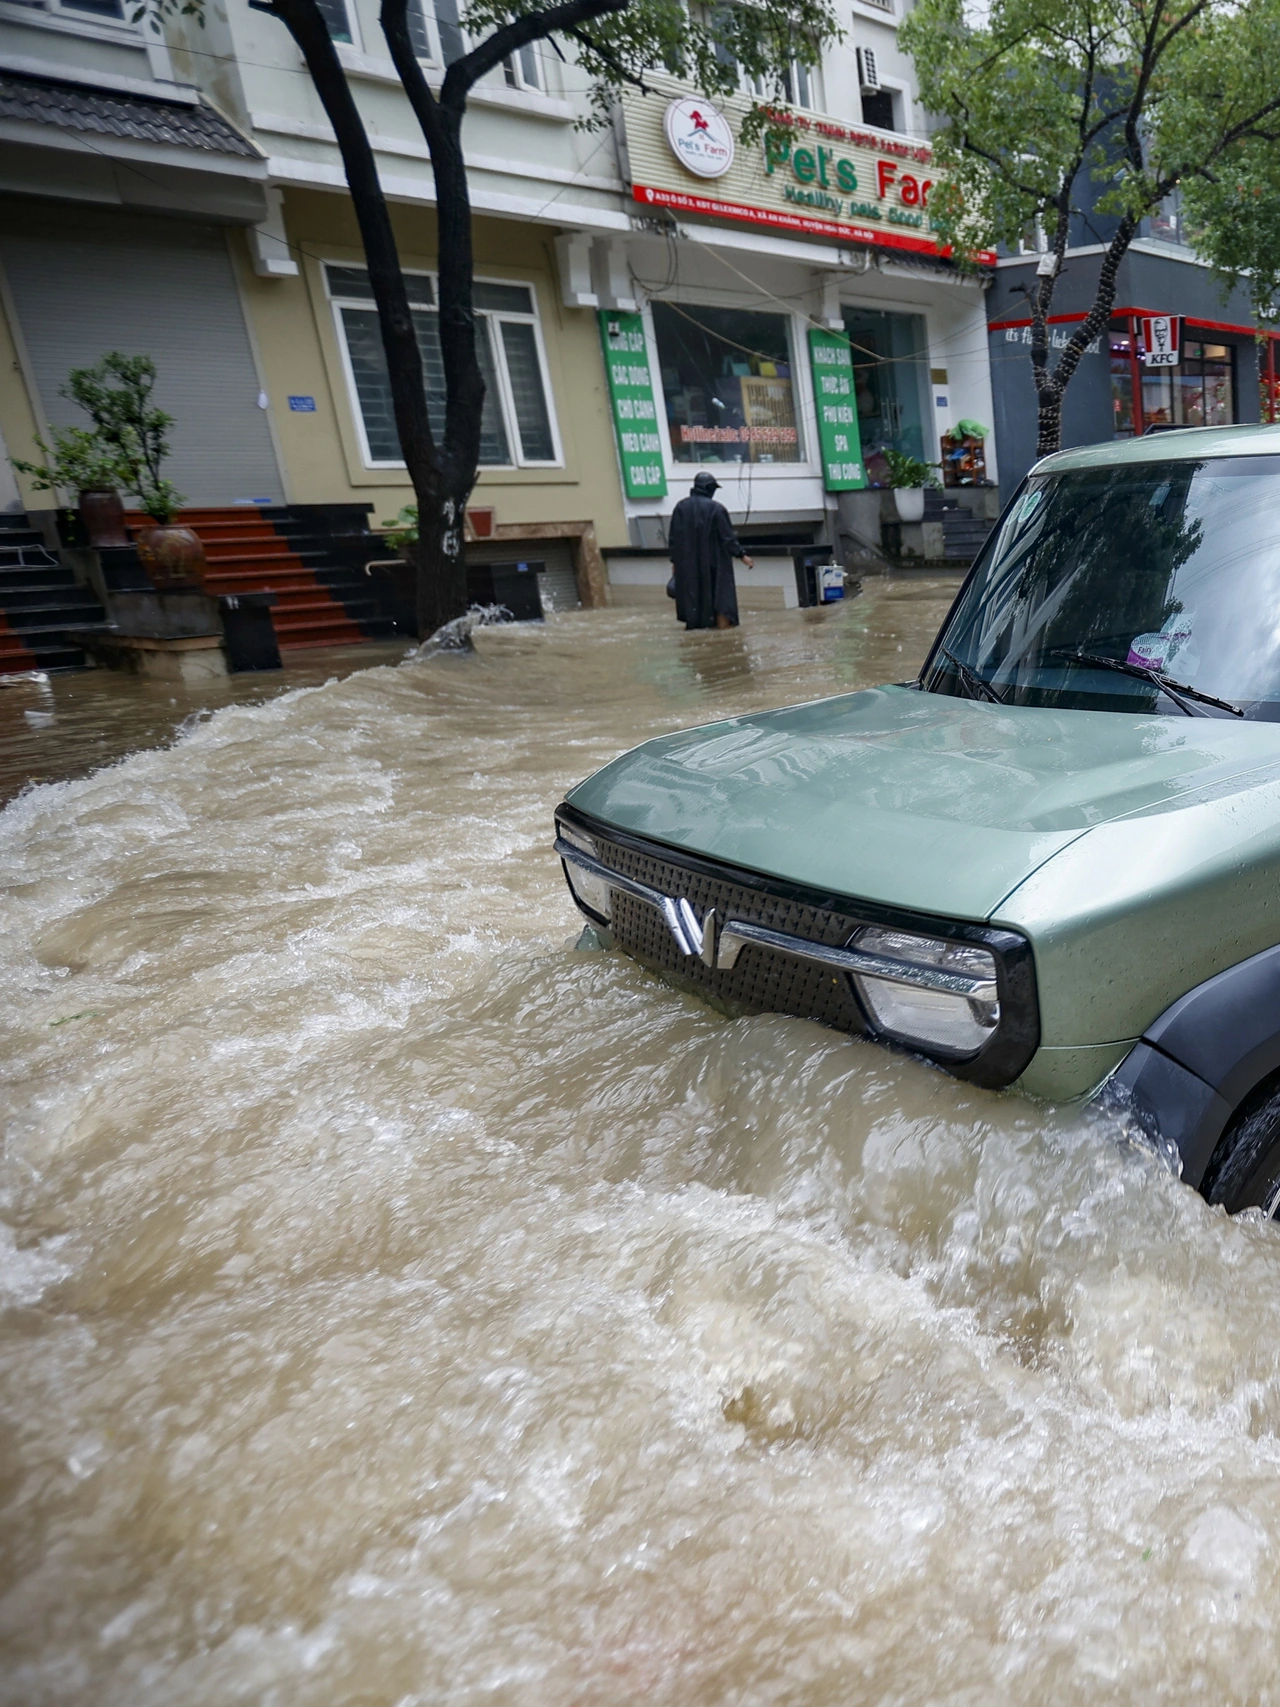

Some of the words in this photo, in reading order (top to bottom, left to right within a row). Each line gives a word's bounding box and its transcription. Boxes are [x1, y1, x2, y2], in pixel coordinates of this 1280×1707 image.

[704, 143, 728, 157] Farm
[763, 128, 859, 193] Pet's
[784, 184, 844, 217] Healthy
[887, 207, 923, 228] Good
[767, 213, 778, 222] AN
[813, 343, 836, 364] KHÁCH
[836, 347, 850, 369] SẠN
[1151, 353, 1174, 364] KFC
[612, 361, 628, 385] CÁC
[824, 405, 838, 427] PHỤ
[838, 403, 854, 427] KIỆN
[834, 434, 849, 452] SPA
[630, 465, 646, 485] CAO
[646, 459, 661, 485] CẤP
[828, 460, 842, 480] THÚ
[842, 462, 861, 480] CƯNG
[1137, 645, 1152, 655] Fairy
